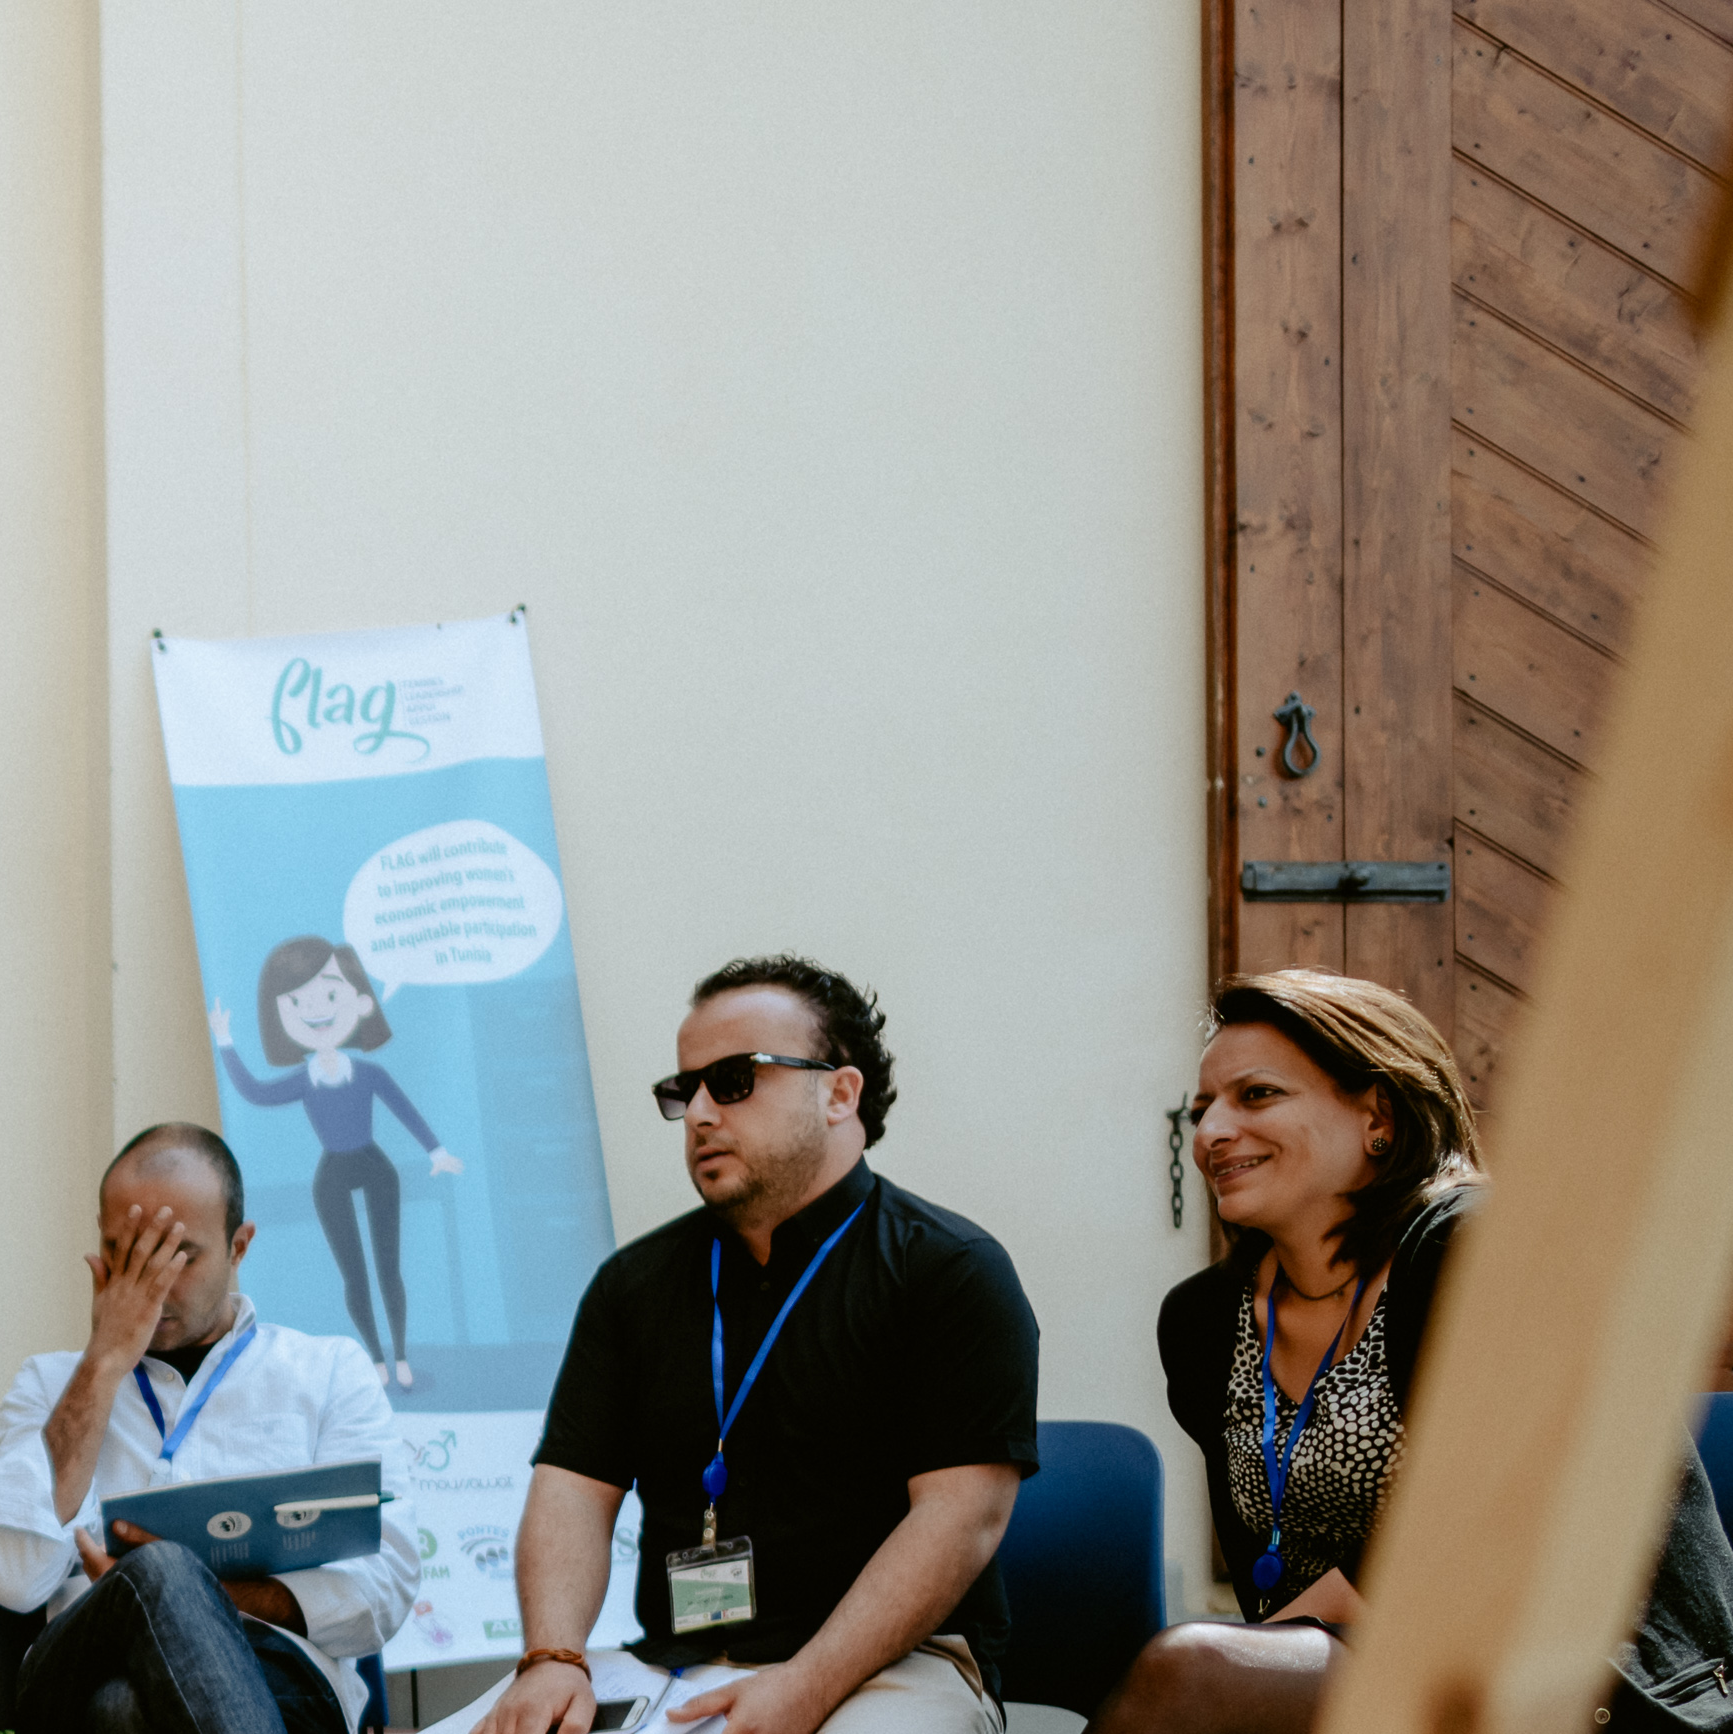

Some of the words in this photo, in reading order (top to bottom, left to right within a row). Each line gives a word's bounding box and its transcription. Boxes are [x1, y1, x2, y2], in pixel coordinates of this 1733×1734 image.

[265, 657, 430, 764] flag
[380, 851, 415, 871] FLAG
[418, 845, 441, 864] will
[444, 837, 508, 858] contribute
[377, 884, 392, 898] to
[394, 870, 463, 896] improving
[465, 867, 515, 883] women's
[374, 902, 437, 925] economic
[440, 895, 525, 912] empowerment
[371, 933, 396, 953] and
[398, 921, 461, 948] equitable
[463, 919, 537, 940] participation
[435, 951, 448, 965] in
[449, 945, 493, 963] Tunisia
[457, 1525, 510, 1541] PONTES
[421, 1565, 451, 1580] FAM
